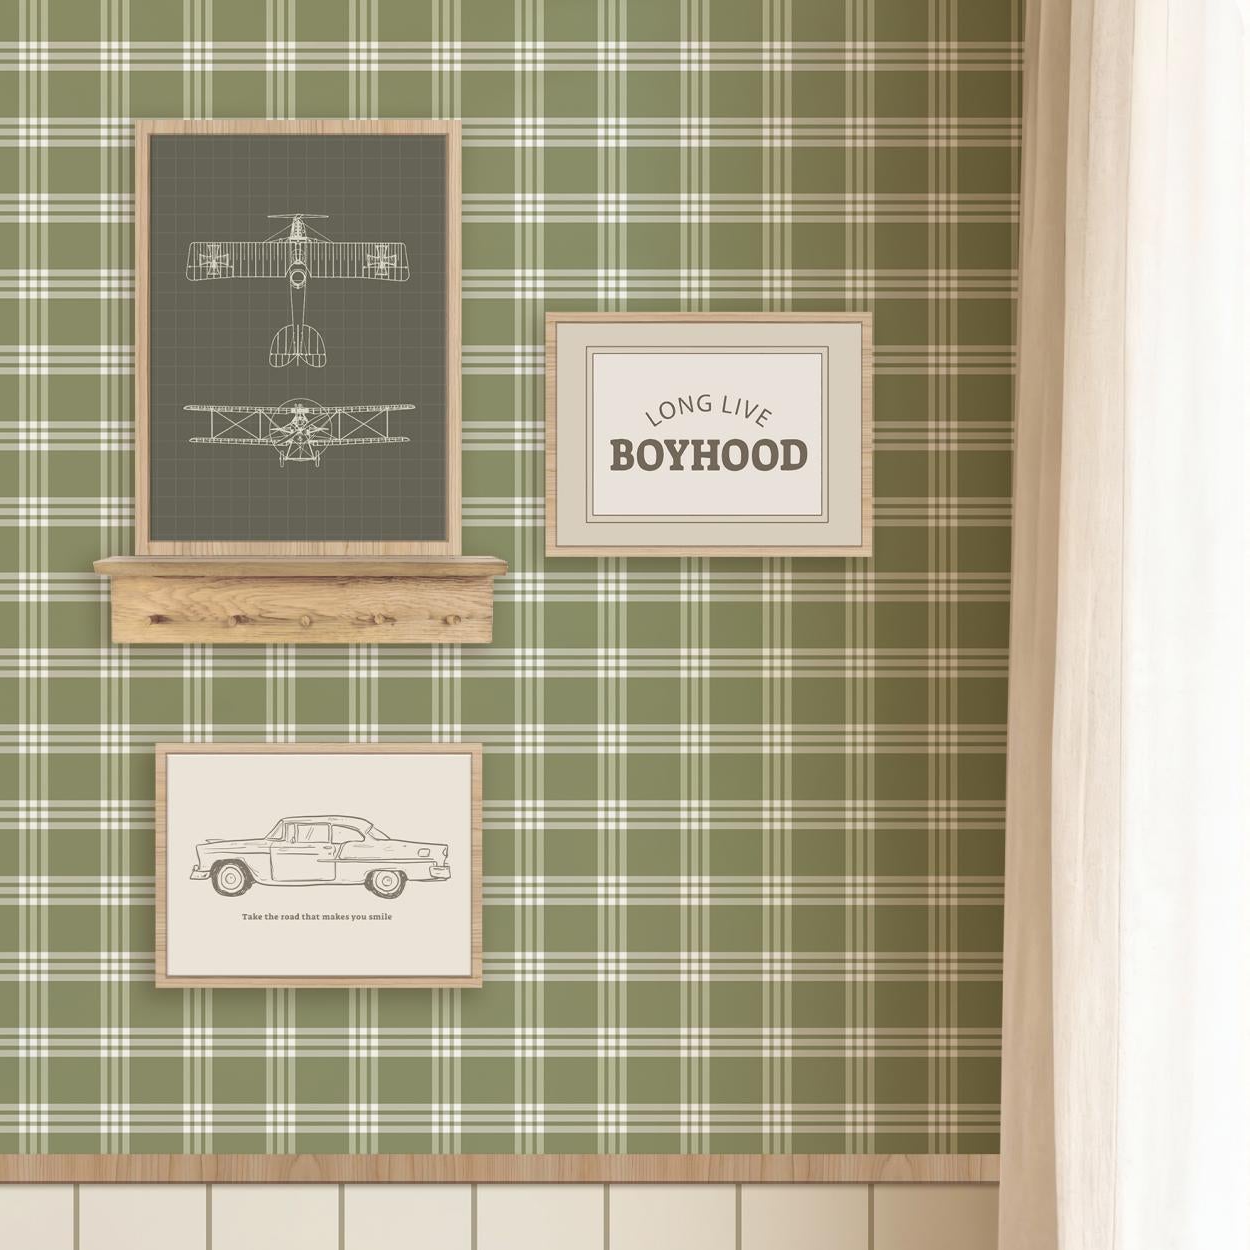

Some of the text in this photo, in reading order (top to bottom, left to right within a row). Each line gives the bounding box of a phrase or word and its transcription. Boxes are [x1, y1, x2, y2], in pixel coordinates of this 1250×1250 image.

[645, 394, 773, 428] LONG LIVE
[610, 438, 808, 471] BOYHOOD
[241, 912, 393, 922] Take the road that makes you smile
